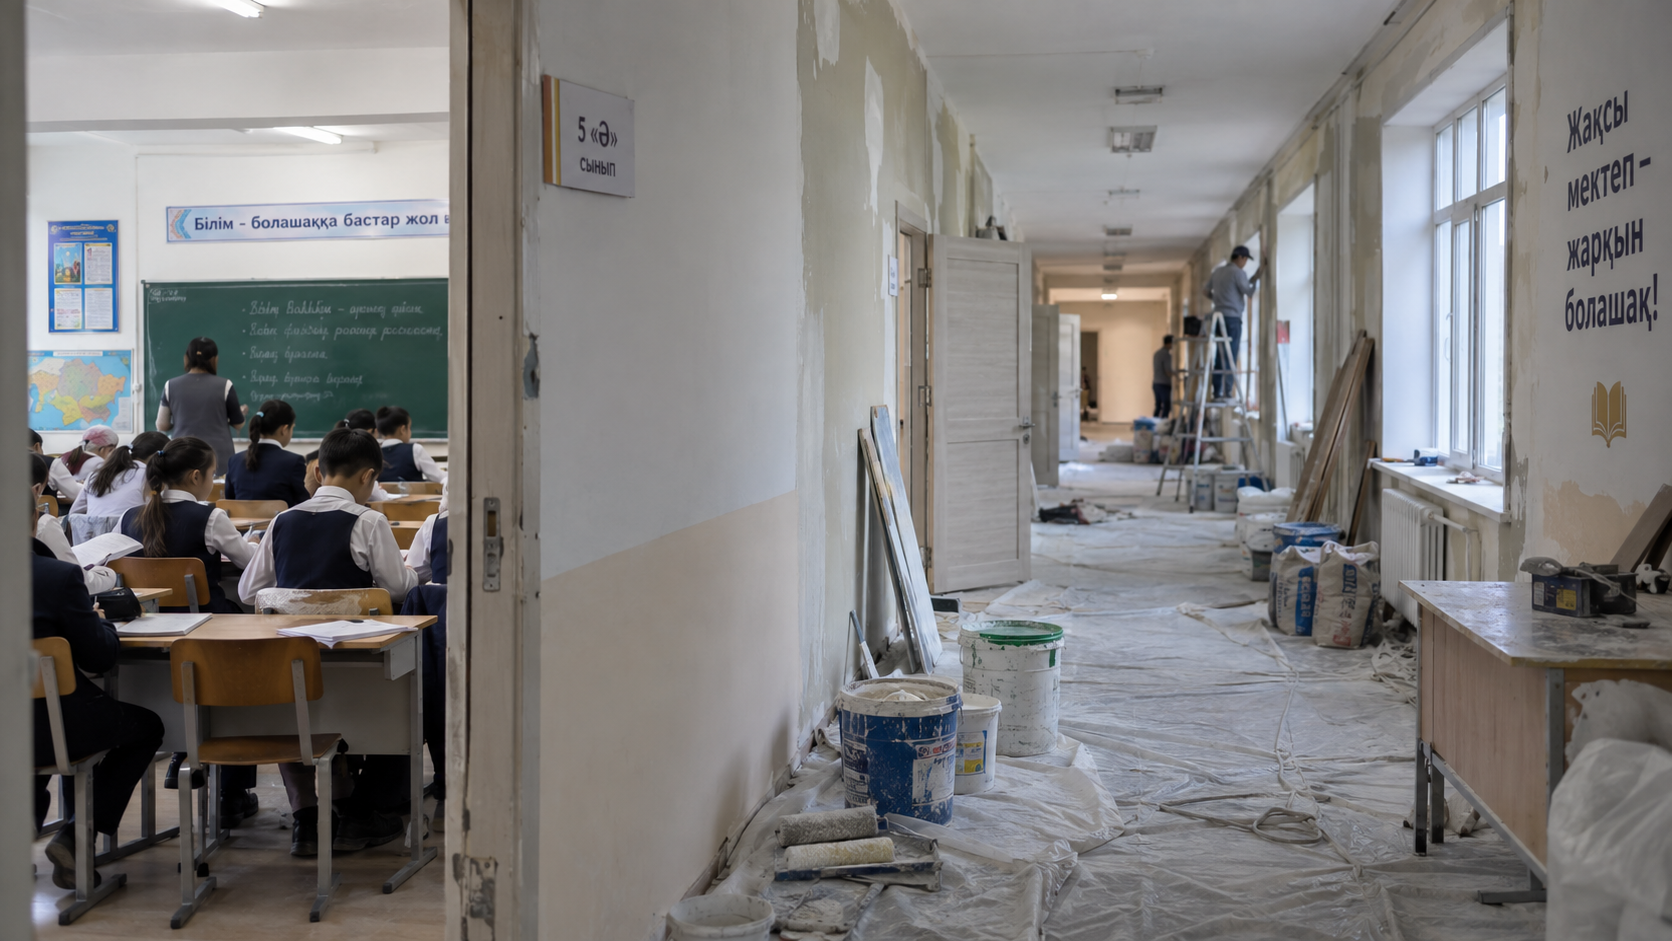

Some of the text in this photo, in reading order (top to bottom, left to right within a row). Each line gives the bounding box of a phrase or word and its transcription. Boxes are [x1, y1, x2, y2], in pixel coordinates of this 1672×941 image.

[578, 116, 618, 148] 5 «Ә»
[1567, 90, 1628, 153] Жақсы
[580, 157, 616, 177] сынып
[1567, 153, 1635, 212] мектеп
[194, 217, 234, 231] Білім
[251, 215, 338, 230] болашаққа
[343, 213, 400, 229] бастар
[405, 215, 438, 225] жол
[1567, 218, 1644, 277] жарқын
[1565, 273, 1658, 332] болашақ!
